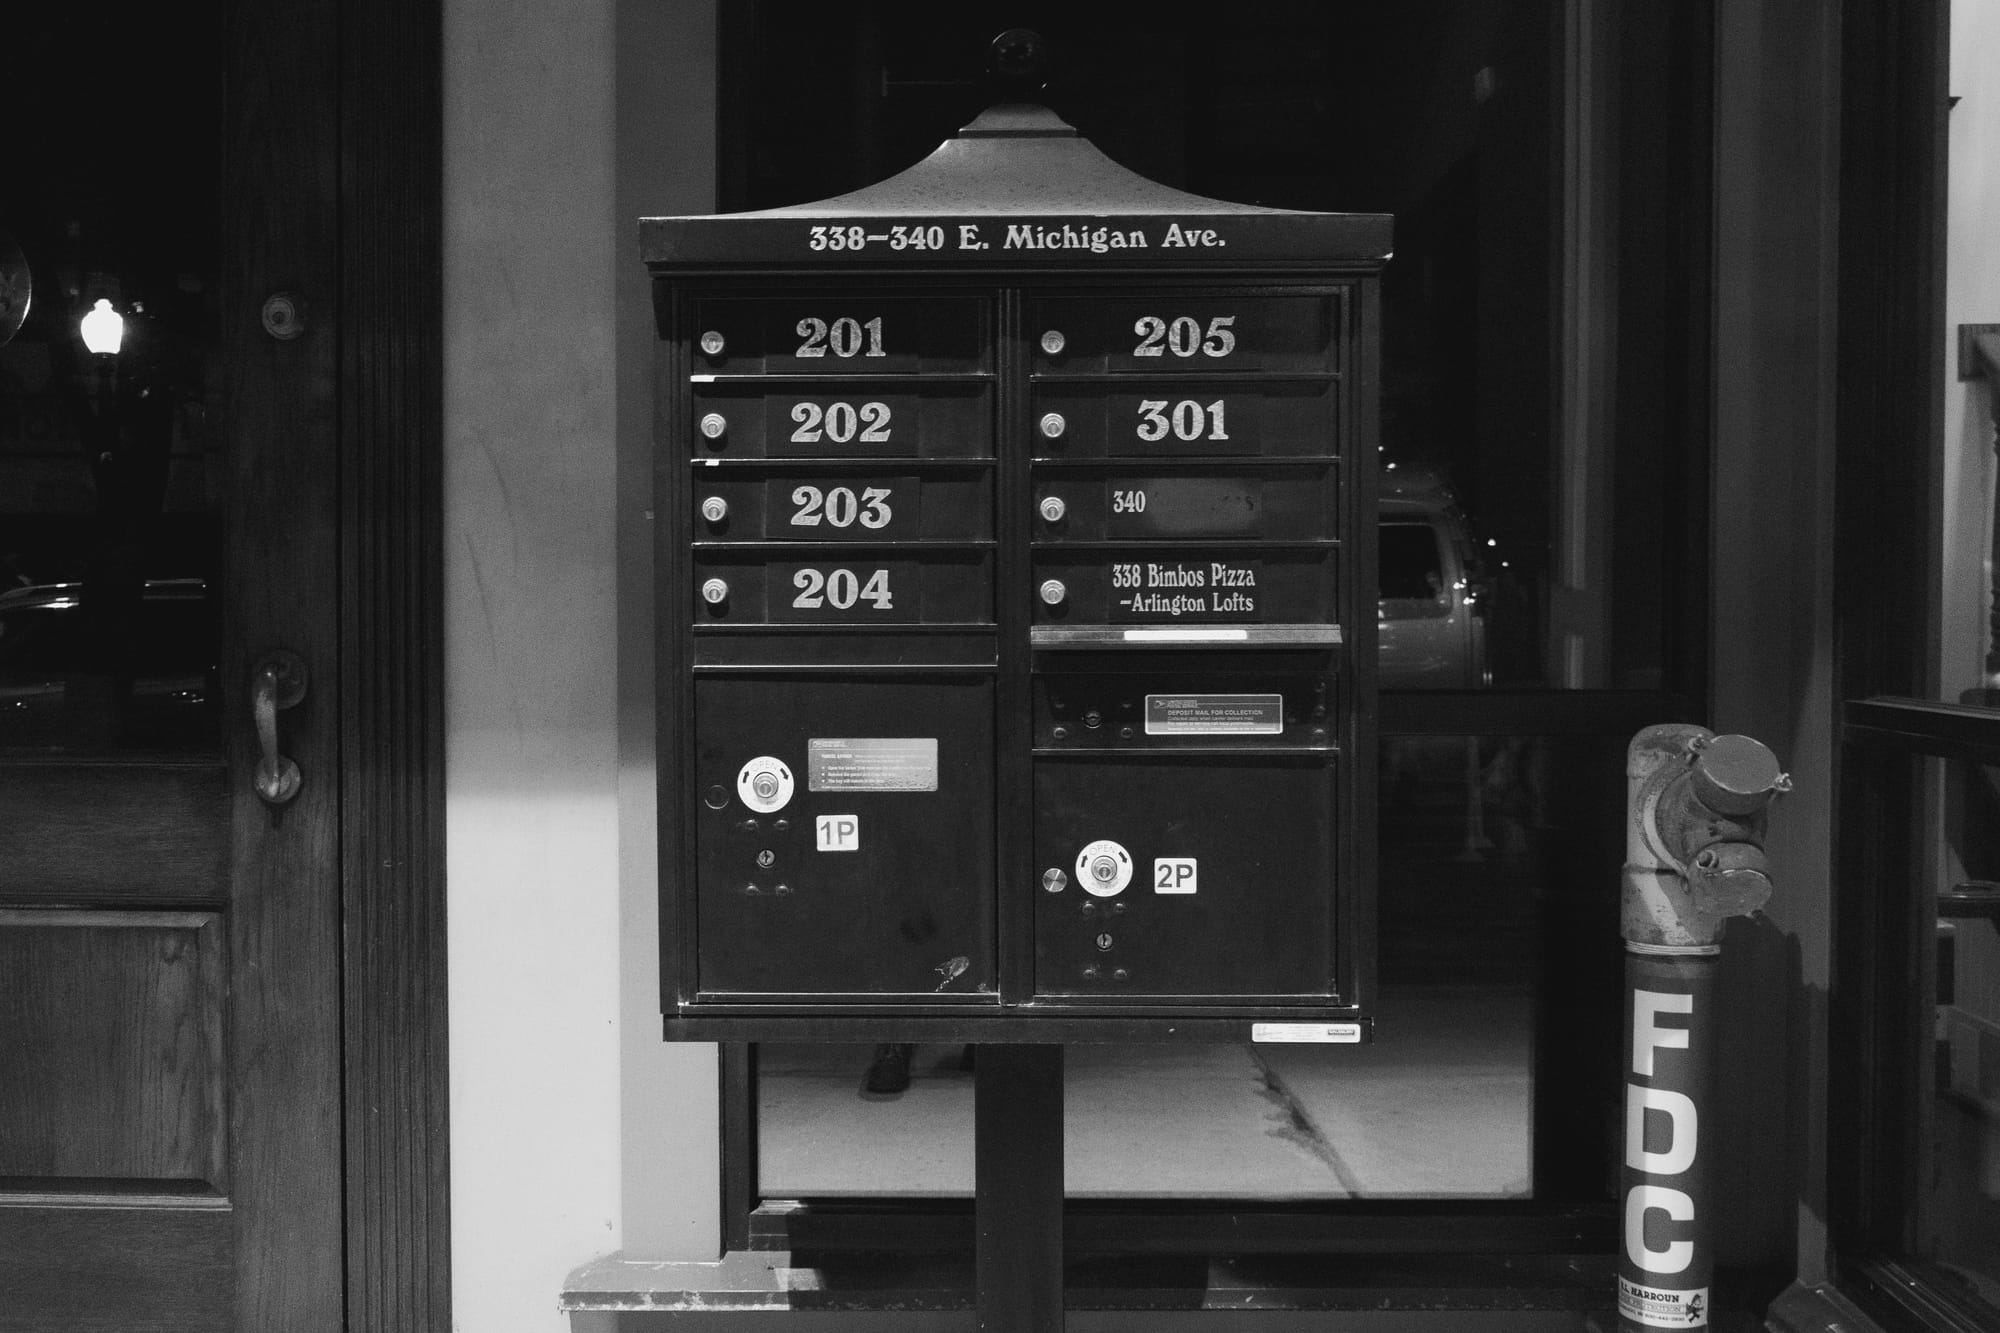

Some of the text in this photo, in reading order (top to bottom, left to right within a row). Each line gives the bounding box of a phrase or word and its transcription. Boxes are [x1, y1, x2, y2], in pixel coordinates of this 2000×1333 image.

[809, 223, 1226, 254] 338-340 E. Michigan Ave.
[795, 316, 887, 358] 201
[1133, 315, 1236, 358] 205
[790, 401, 892, 444] 202
[1136, 399, 1230, 442] 301
[790, 485, 893, 529] 203
[1113, 490, 1146, 513] 340
[792, 568, 894, 610] 204
[1112, 562, 1256, 588] 338 Bimbos Pizza
[1212, 591, 1254, 612] Lofts
[820, 821, 855, 845] 1P
[1157, 863, 1194, 888] 2P
[1625, 988, 1698, 1275] FDC
[1631, 1287, 1679, 1302] HARROUN
